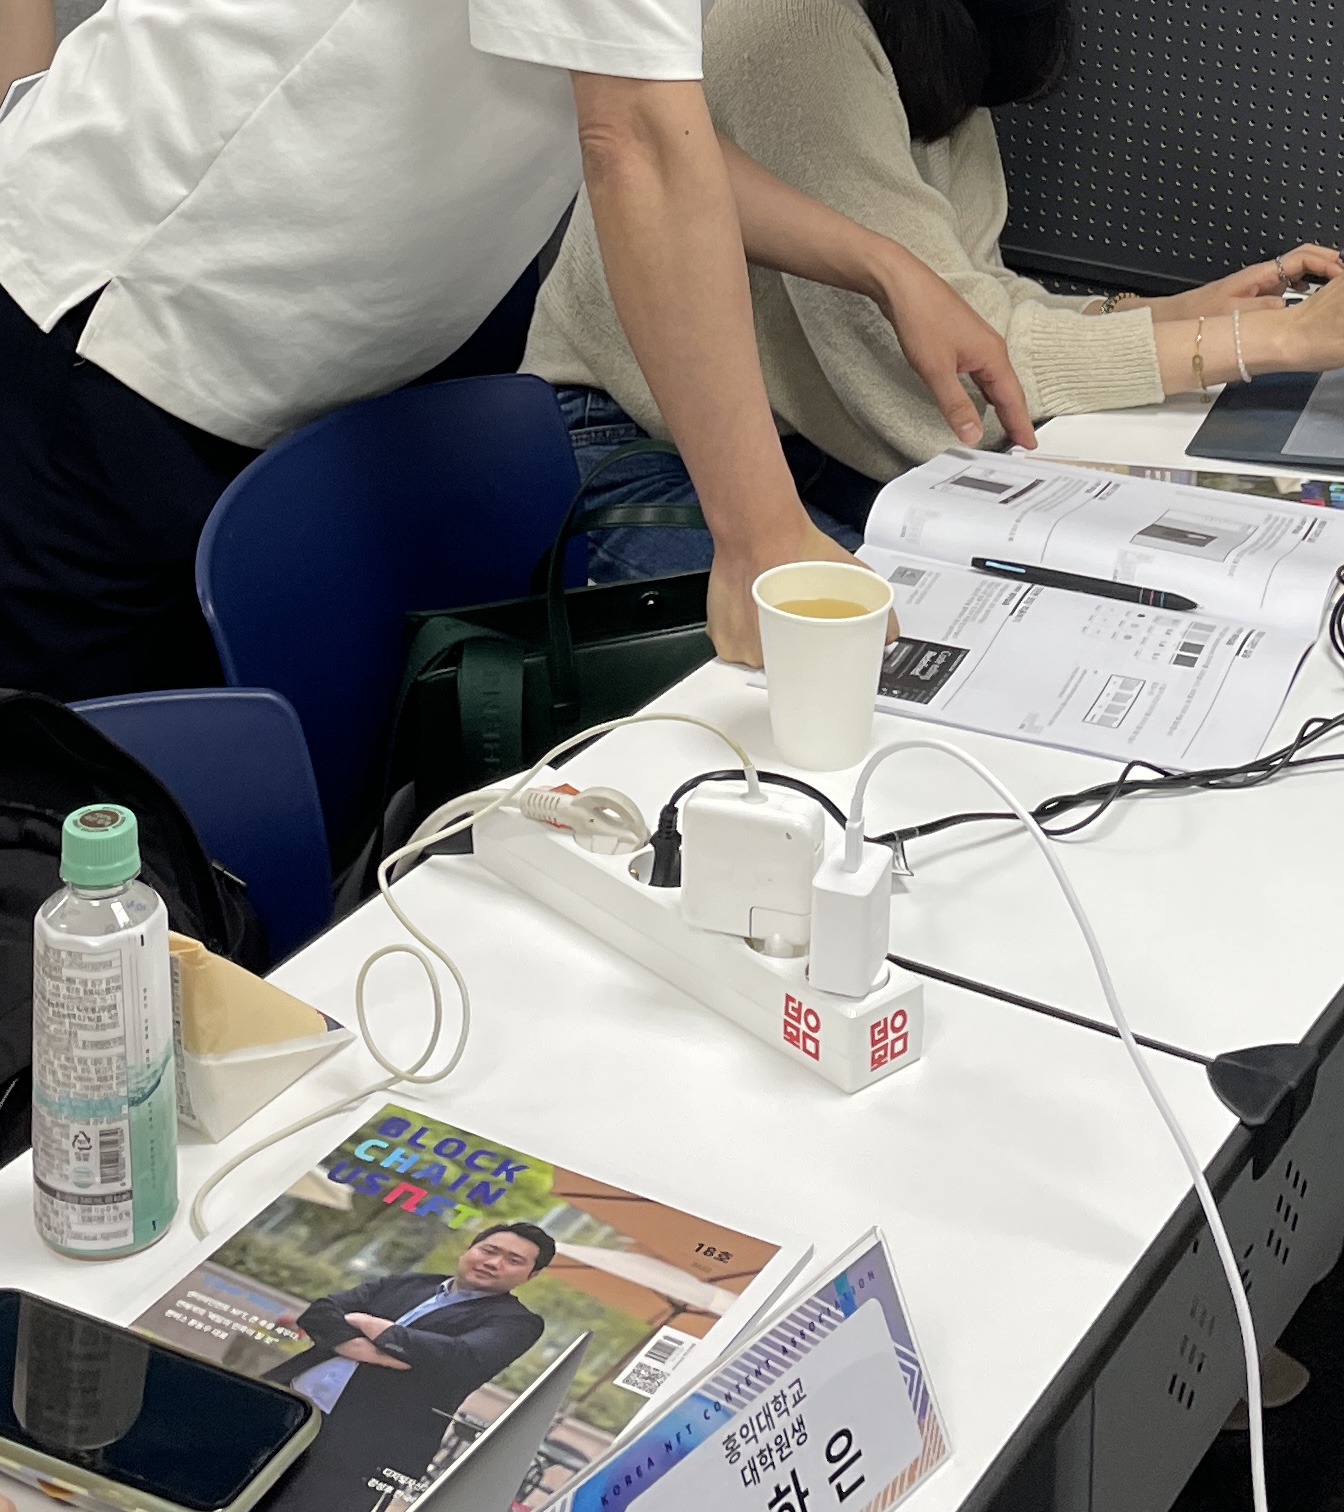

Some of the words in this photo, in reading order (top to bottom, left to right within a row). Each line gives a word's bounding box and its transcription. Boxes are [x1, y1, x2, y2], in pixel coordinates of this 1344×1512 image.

[353, 1138, 507, 1207] CHAIN
[375, 1116, 529, 1184] BLOCK
[722, 1377, 807, 1466] 홍익대학교
[740, 1414, 808, 1488] 대학원생
[599, 1455, 656, 1506] KOREA
[664, 1423, 694, 1455] NFT
